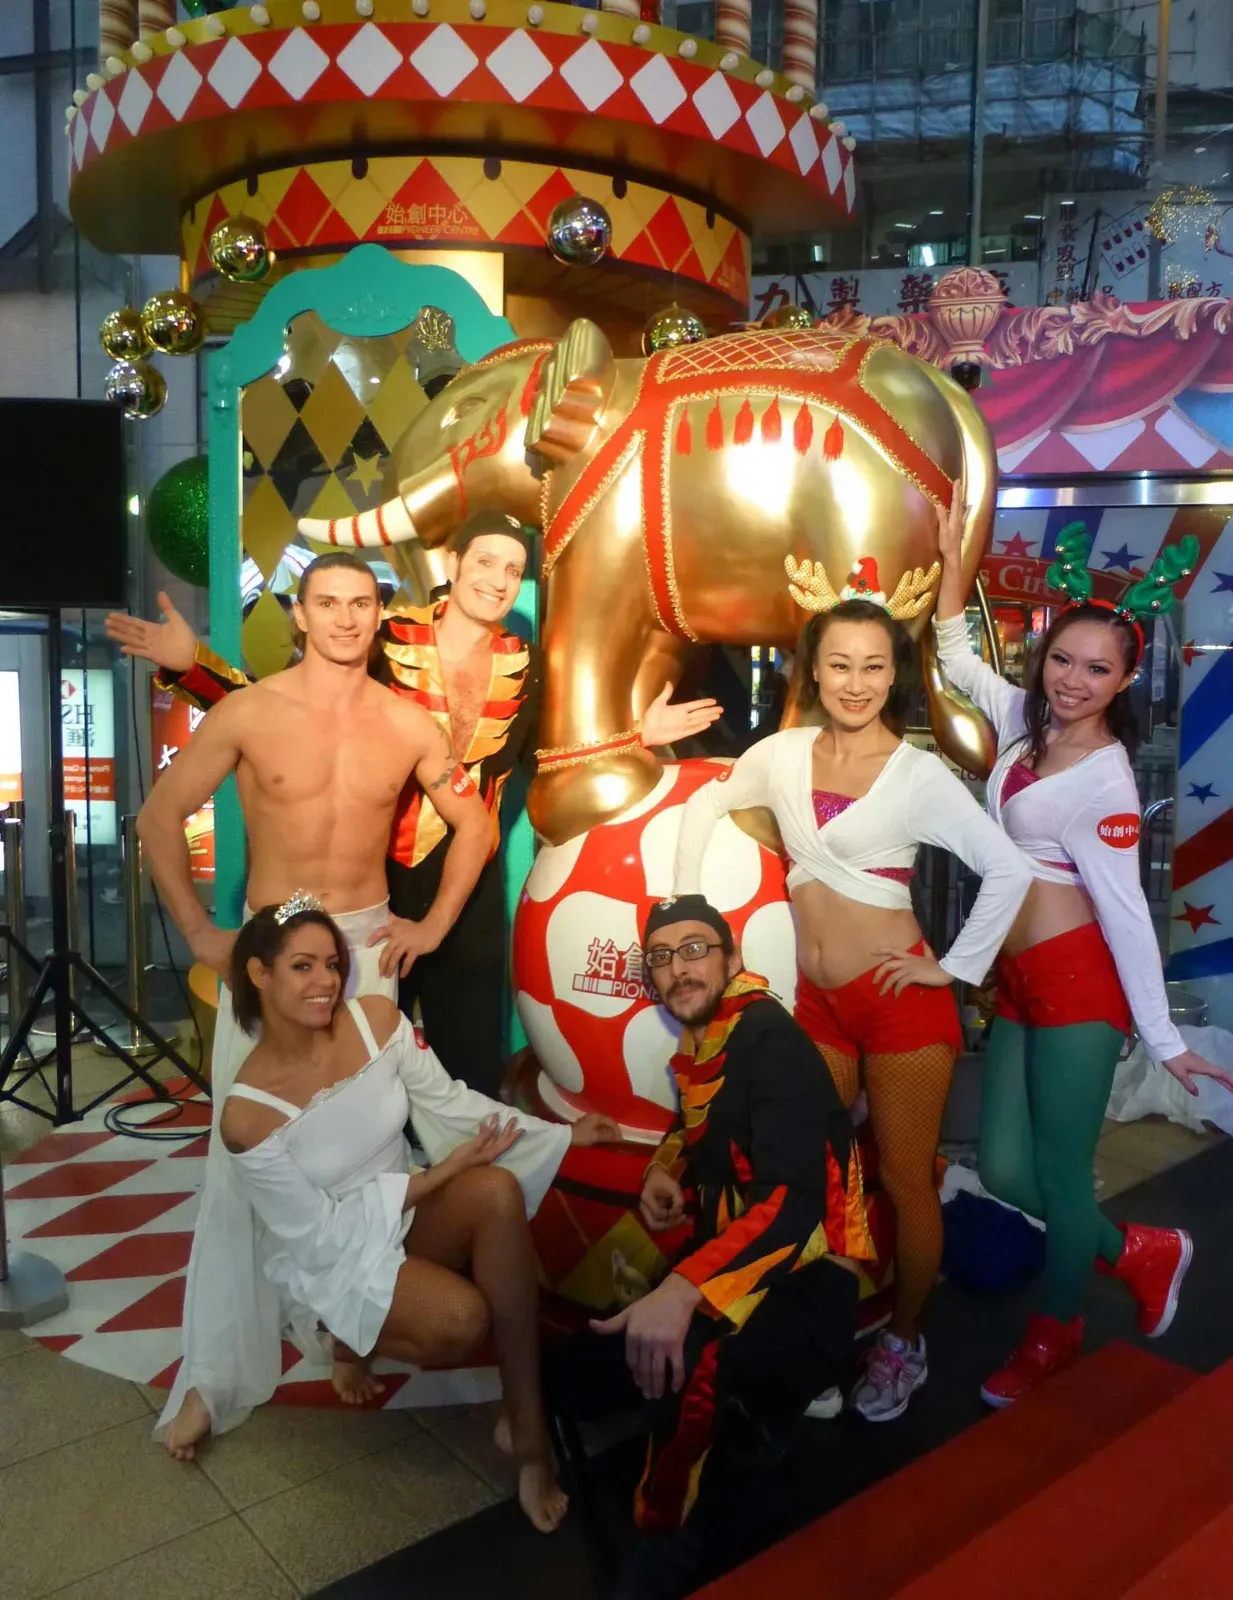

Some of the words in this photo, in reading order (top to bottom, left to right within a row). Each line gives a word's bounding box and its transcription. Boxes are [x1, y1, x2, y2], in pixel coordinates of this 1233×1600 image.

[385, 203, 469, 225] 始創中心
[403, 225, 441, 234] PIONEER
[443, 225, 480, 235] CENTRE
